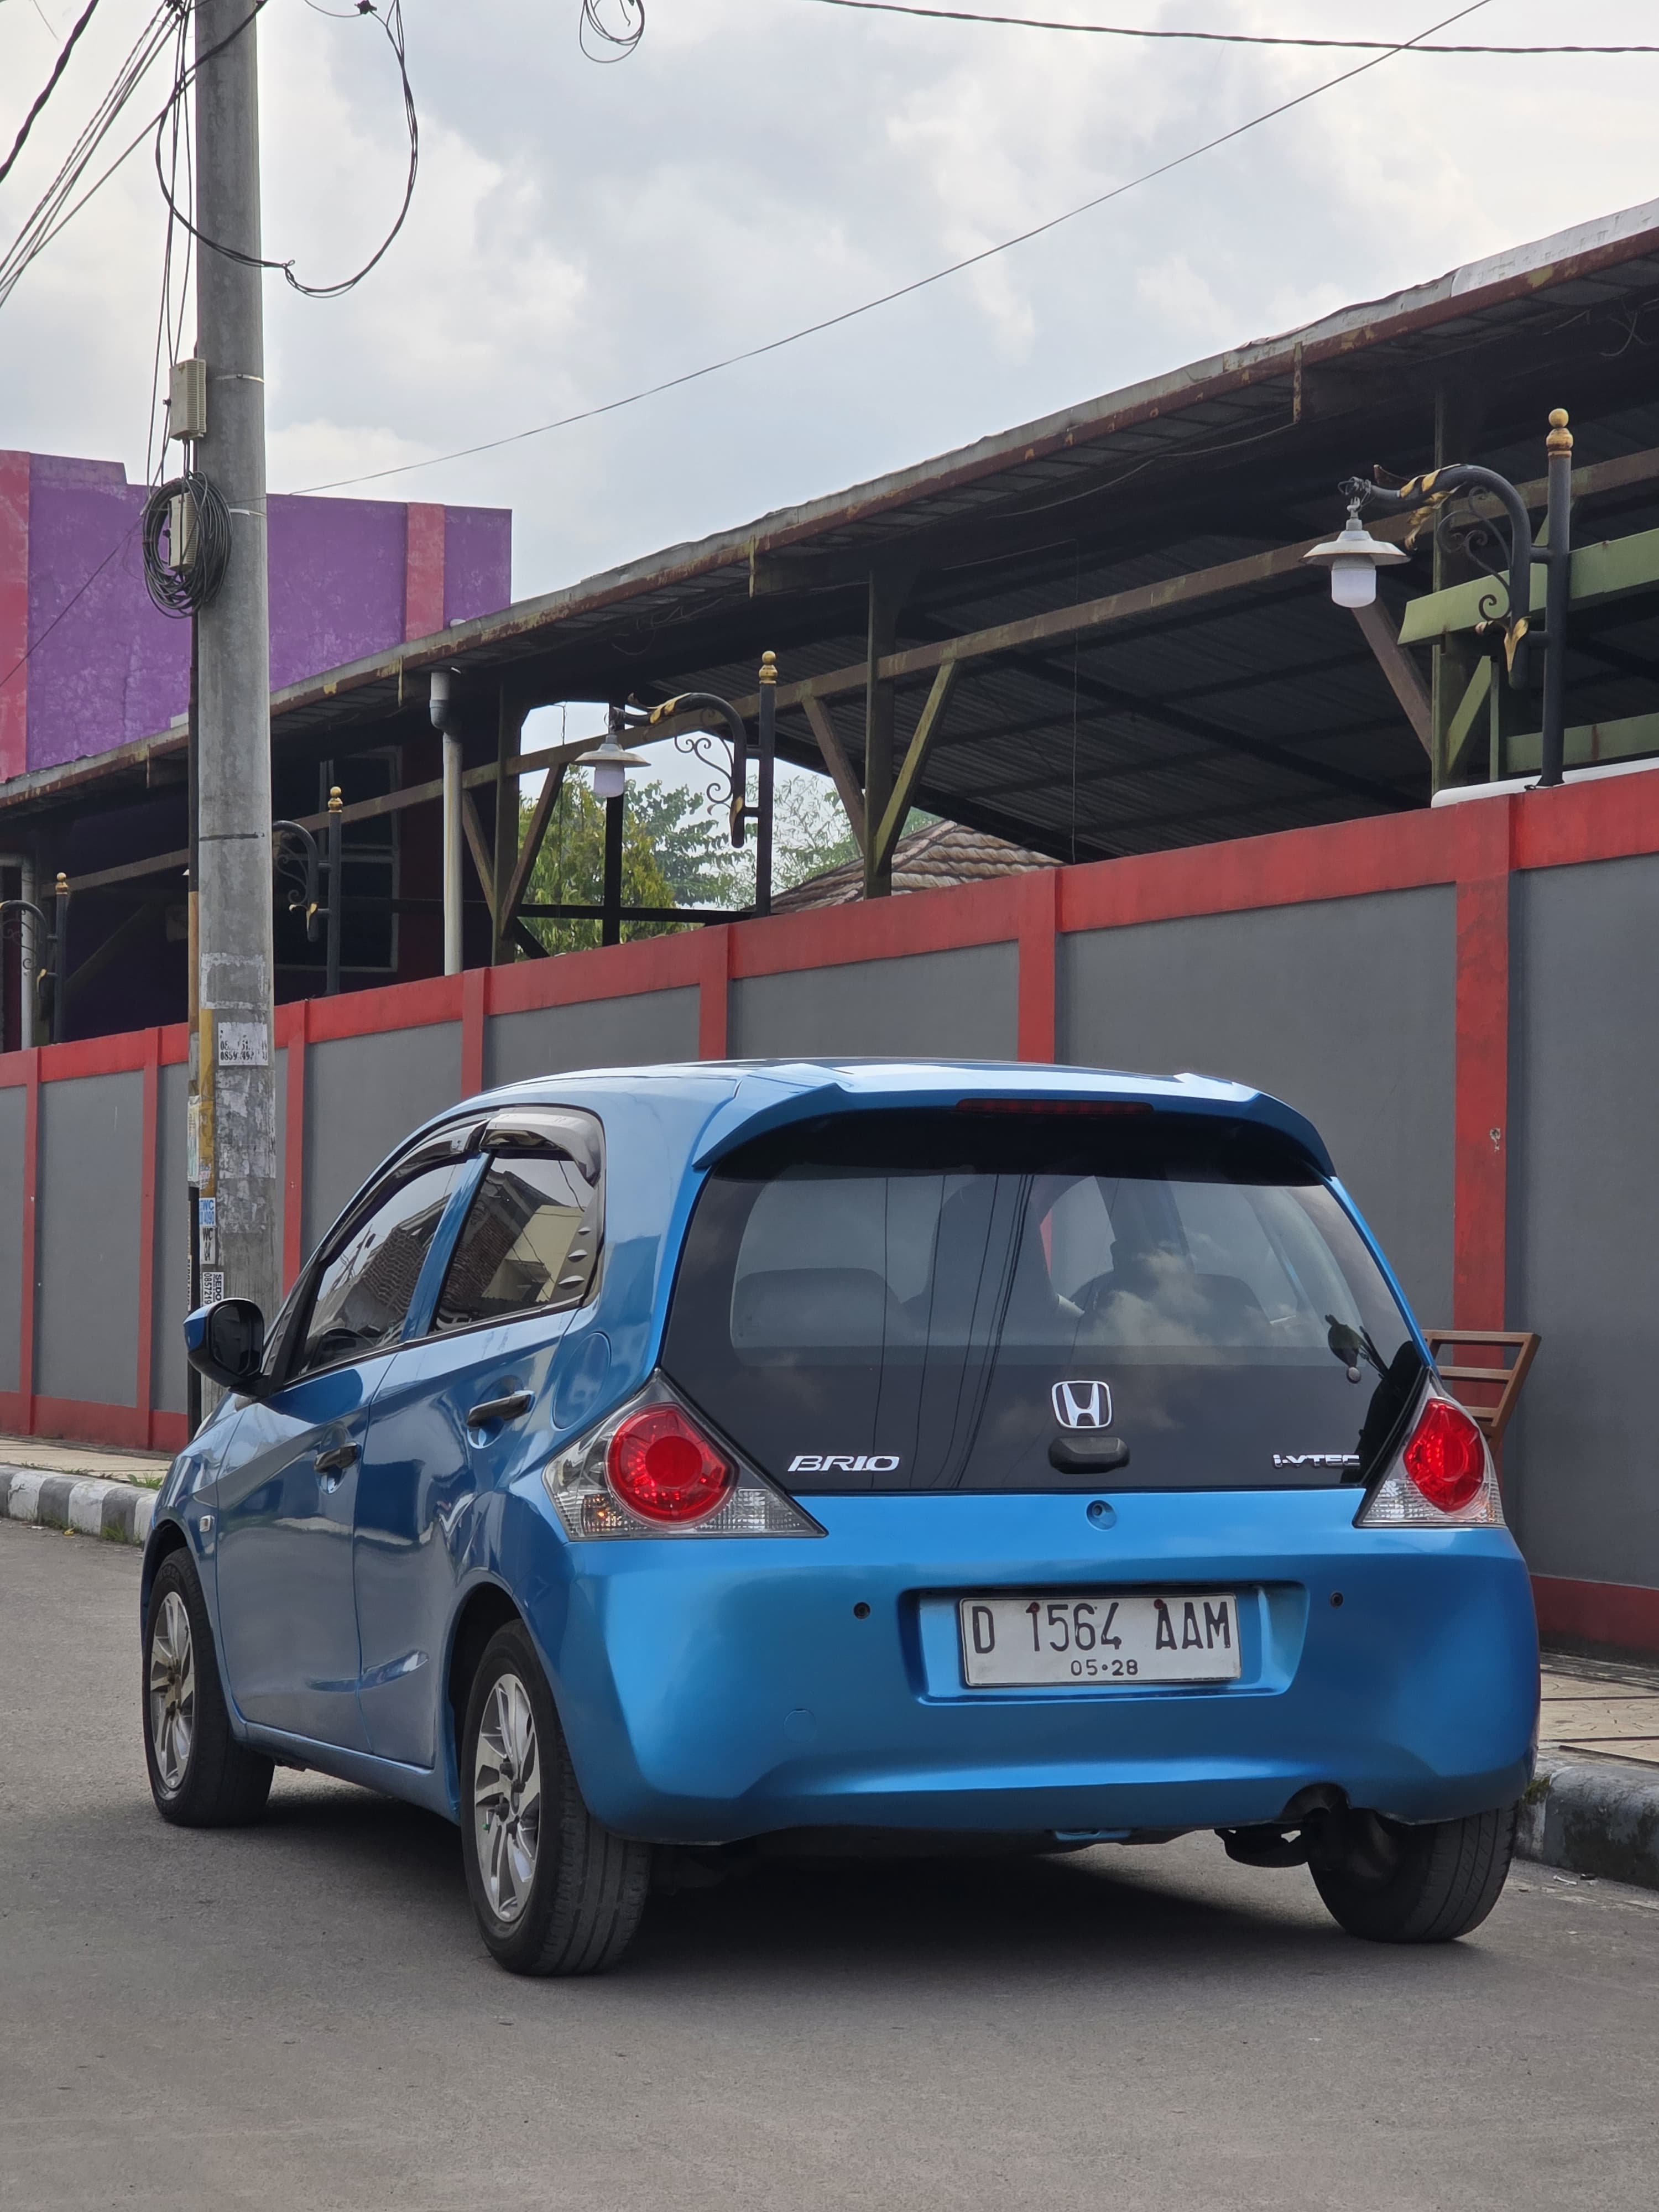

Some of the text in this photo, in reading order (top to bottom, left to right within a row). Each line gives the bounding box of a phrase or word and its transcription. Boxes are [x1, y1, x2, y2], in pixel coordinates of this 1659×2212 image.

[787, 1455, 900, 1472] BRIO
[972, 1601, 1231, 1654] D 1564 AAM
